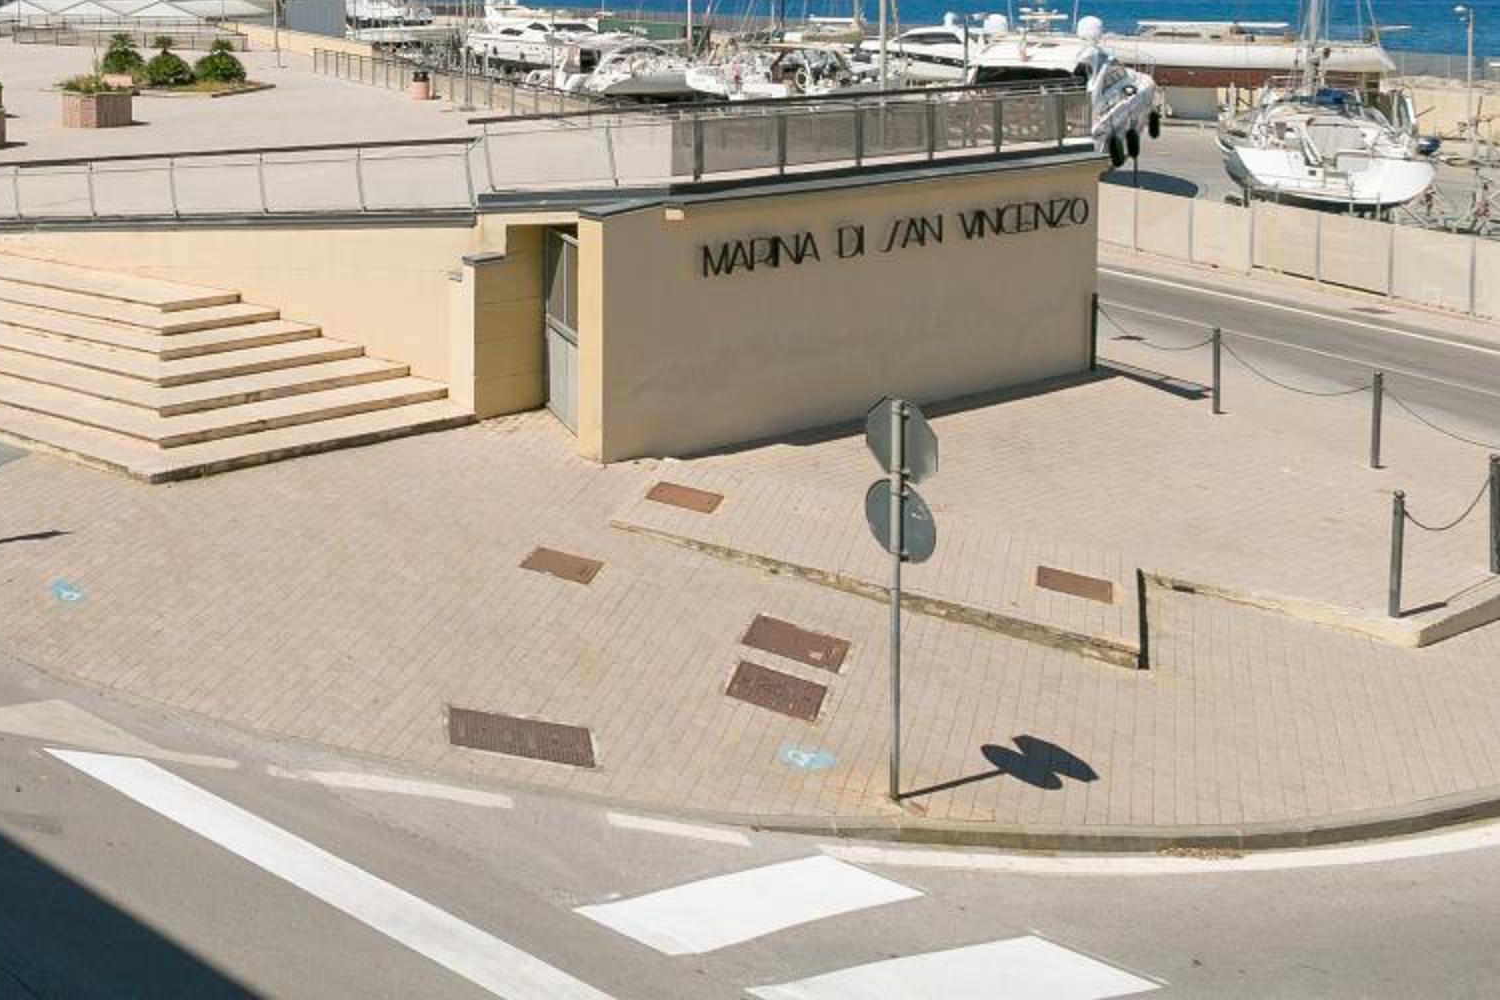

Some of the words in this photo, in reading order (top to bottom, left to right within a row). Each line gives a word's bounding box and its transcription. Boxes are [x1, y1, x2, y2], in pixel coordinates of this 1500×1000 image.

[702, 231, 820, 277] MARINA
[838, 225, 864, 259] DI
[879, 214, 943, 252] SAN
[957, 198, 1089, 240] VINCENZO
